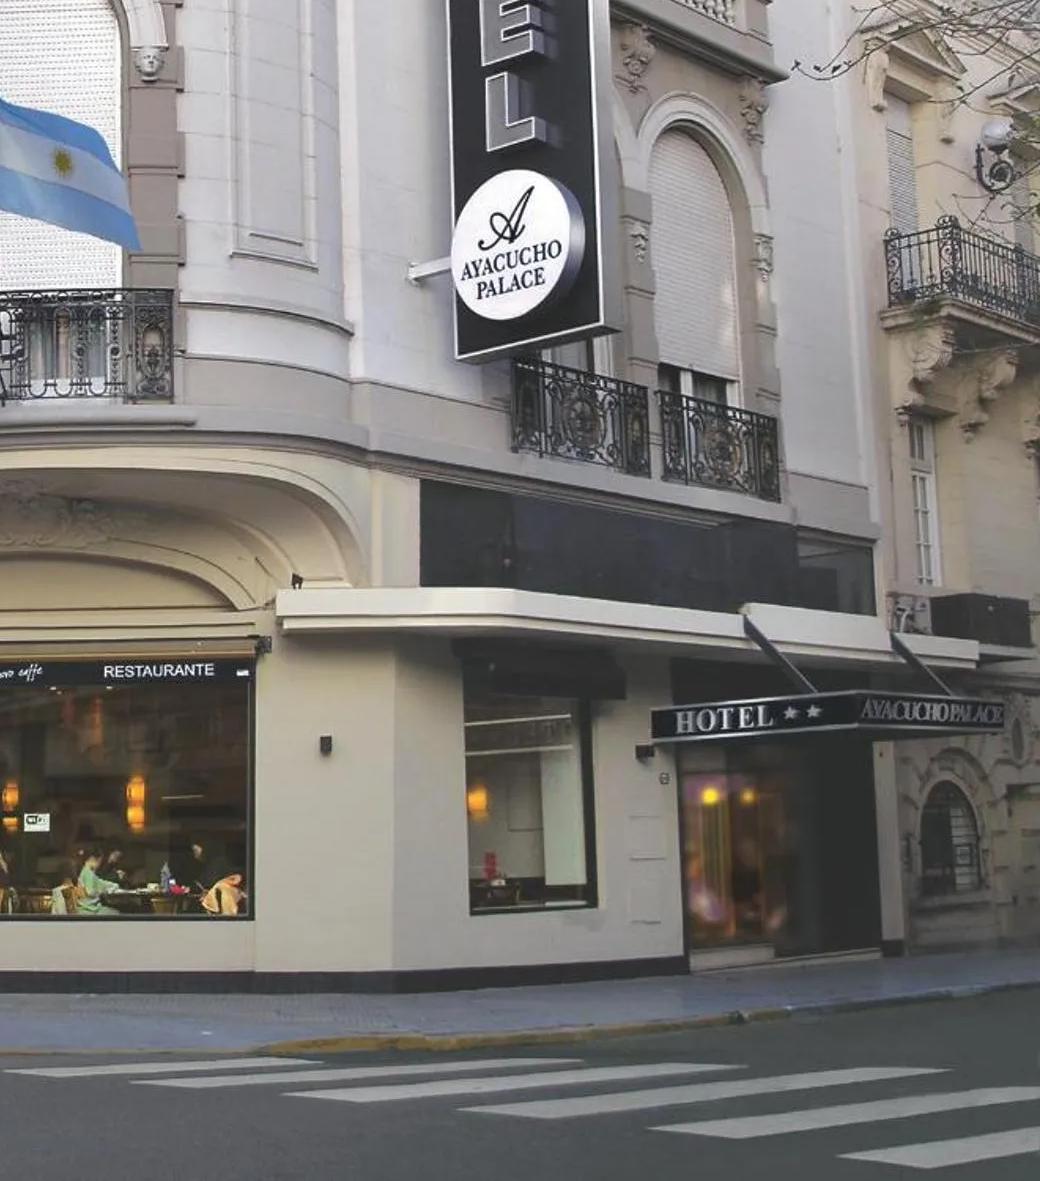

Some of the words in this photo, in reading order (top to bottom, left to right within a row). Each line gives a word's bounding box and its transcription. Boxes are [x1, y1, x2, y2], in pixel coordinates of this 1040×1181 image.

[478, 185, 535, 251] A
[460, 239, 562, 281] AYACUCHO
[477, 267, 546, 300] PALACE
[103, 663, 215, 678] RESTAURANTE
[675, 705, 774, 734] HOTEL
[861, 697, 949, 721] AYACUCHO
